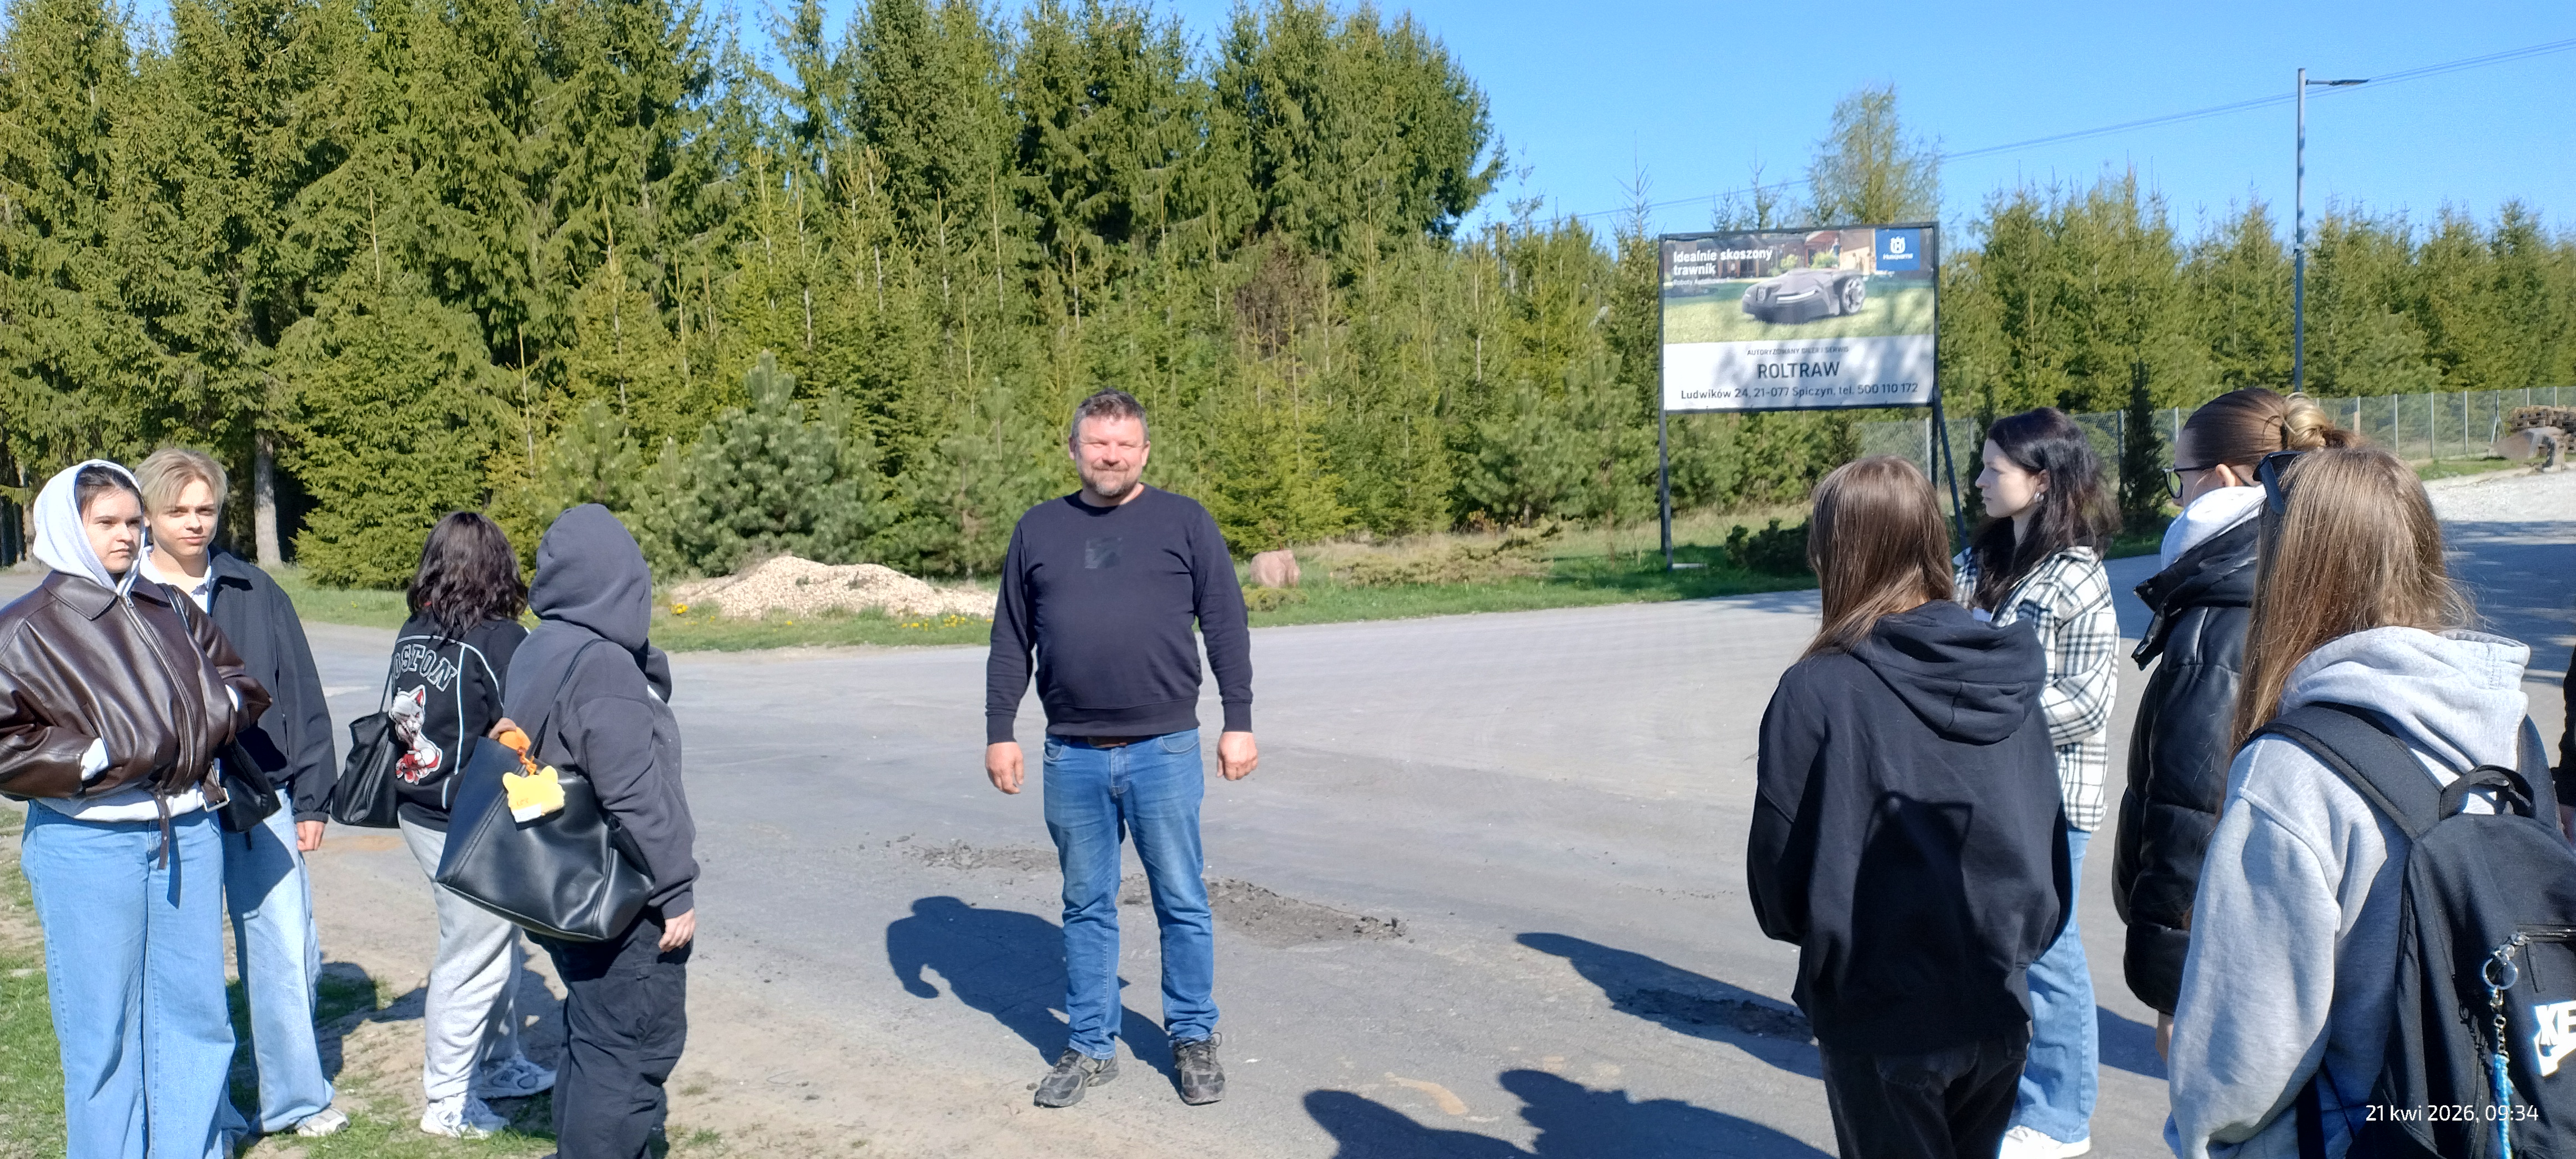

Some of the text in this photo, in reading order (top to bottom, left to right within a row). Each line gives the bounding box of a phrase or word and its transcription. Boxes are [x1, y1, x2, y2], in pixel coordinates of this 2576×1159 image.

[1673, 248, 1773, 263] Idealnie skoszony
[1673, 263, 1716, 275] trawnik
[1757, 361, 1840, 379] ROLTRAW
[1681, 382, 1918, 399] Ludwików 24, 21-077 Spiczyn, tel. 500 110 172
[392, 643, 458, 692] OSTON
